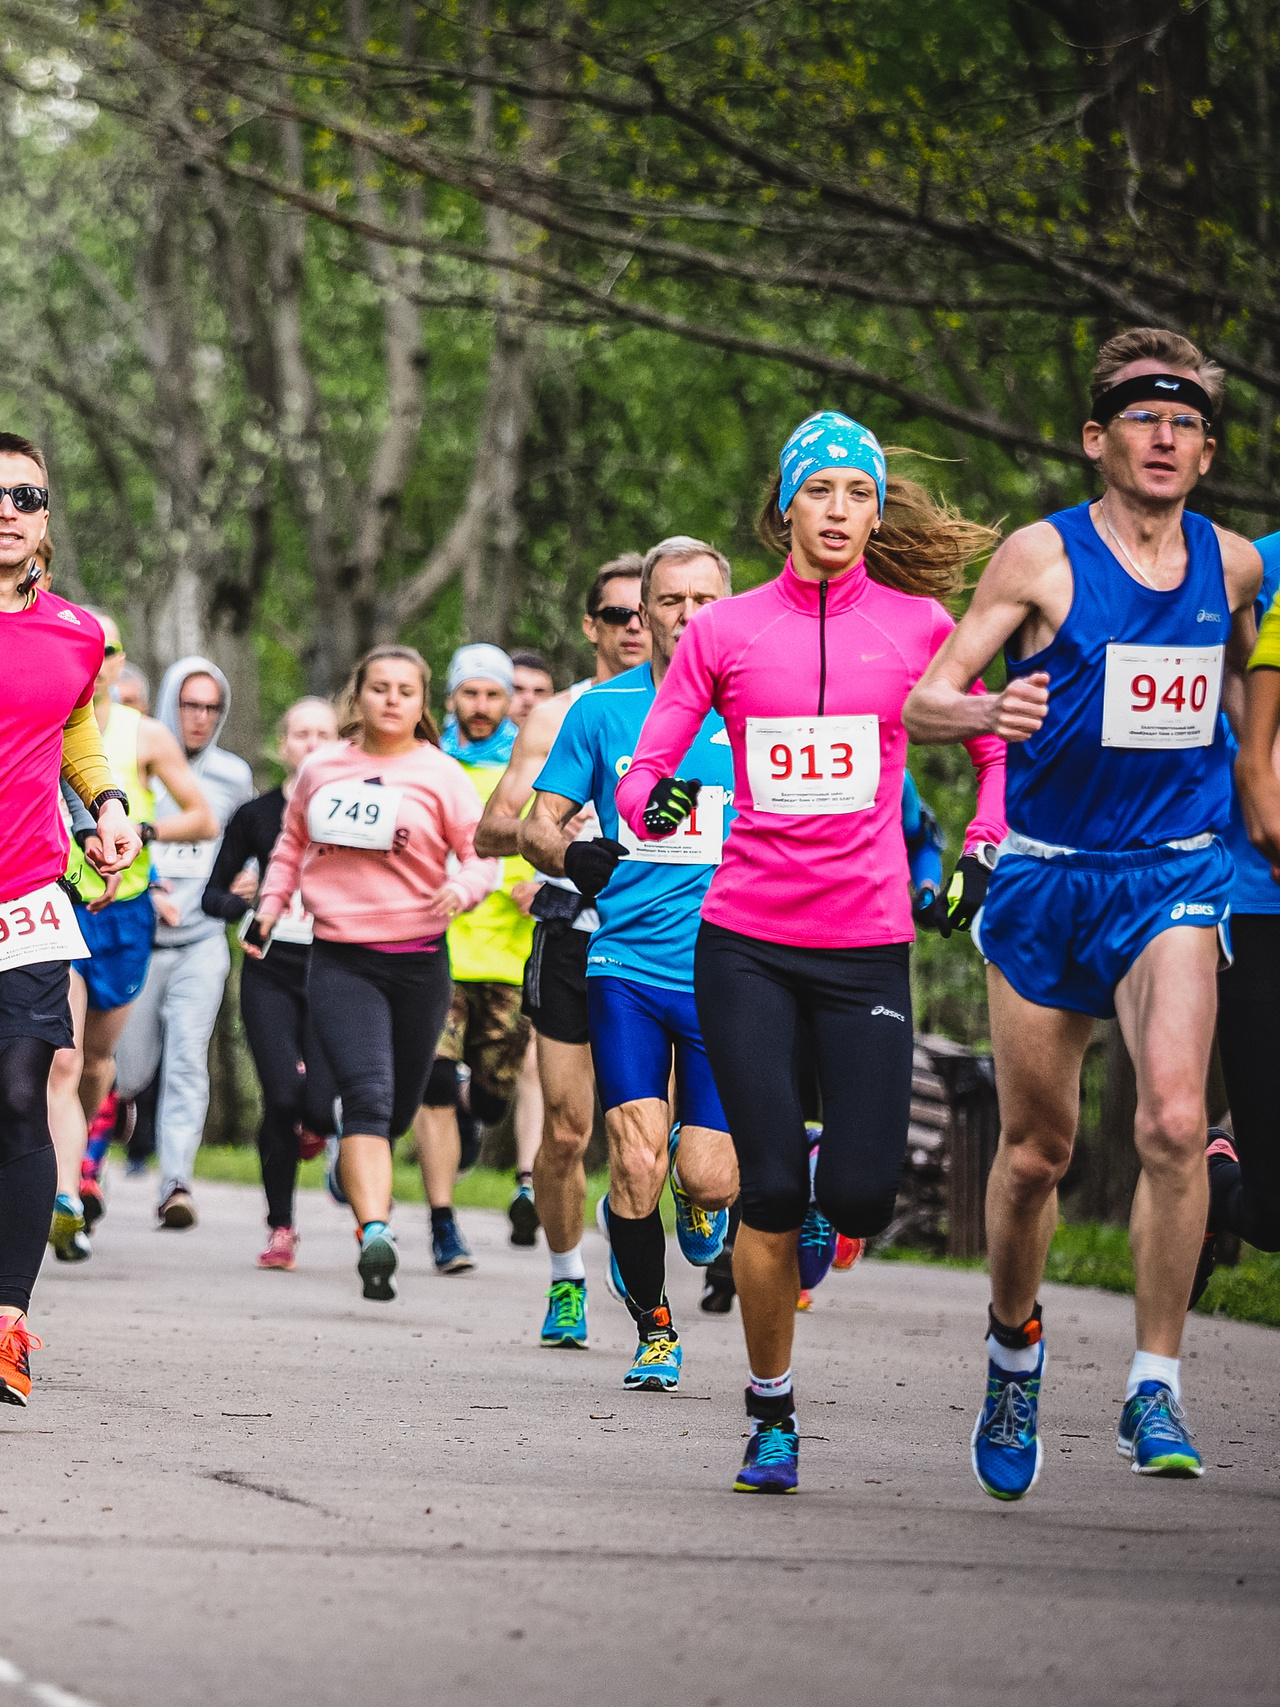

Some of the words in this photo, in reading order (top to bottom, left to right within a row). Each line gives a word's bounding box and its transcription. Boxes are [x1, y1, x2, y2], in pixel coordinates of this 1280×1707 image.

[1130, 674, 1208, 713] 940
[769, 743, 854, 780] 913
[327, 798, 380, 825] 749
[1186, 904, 1215, 916] asics
